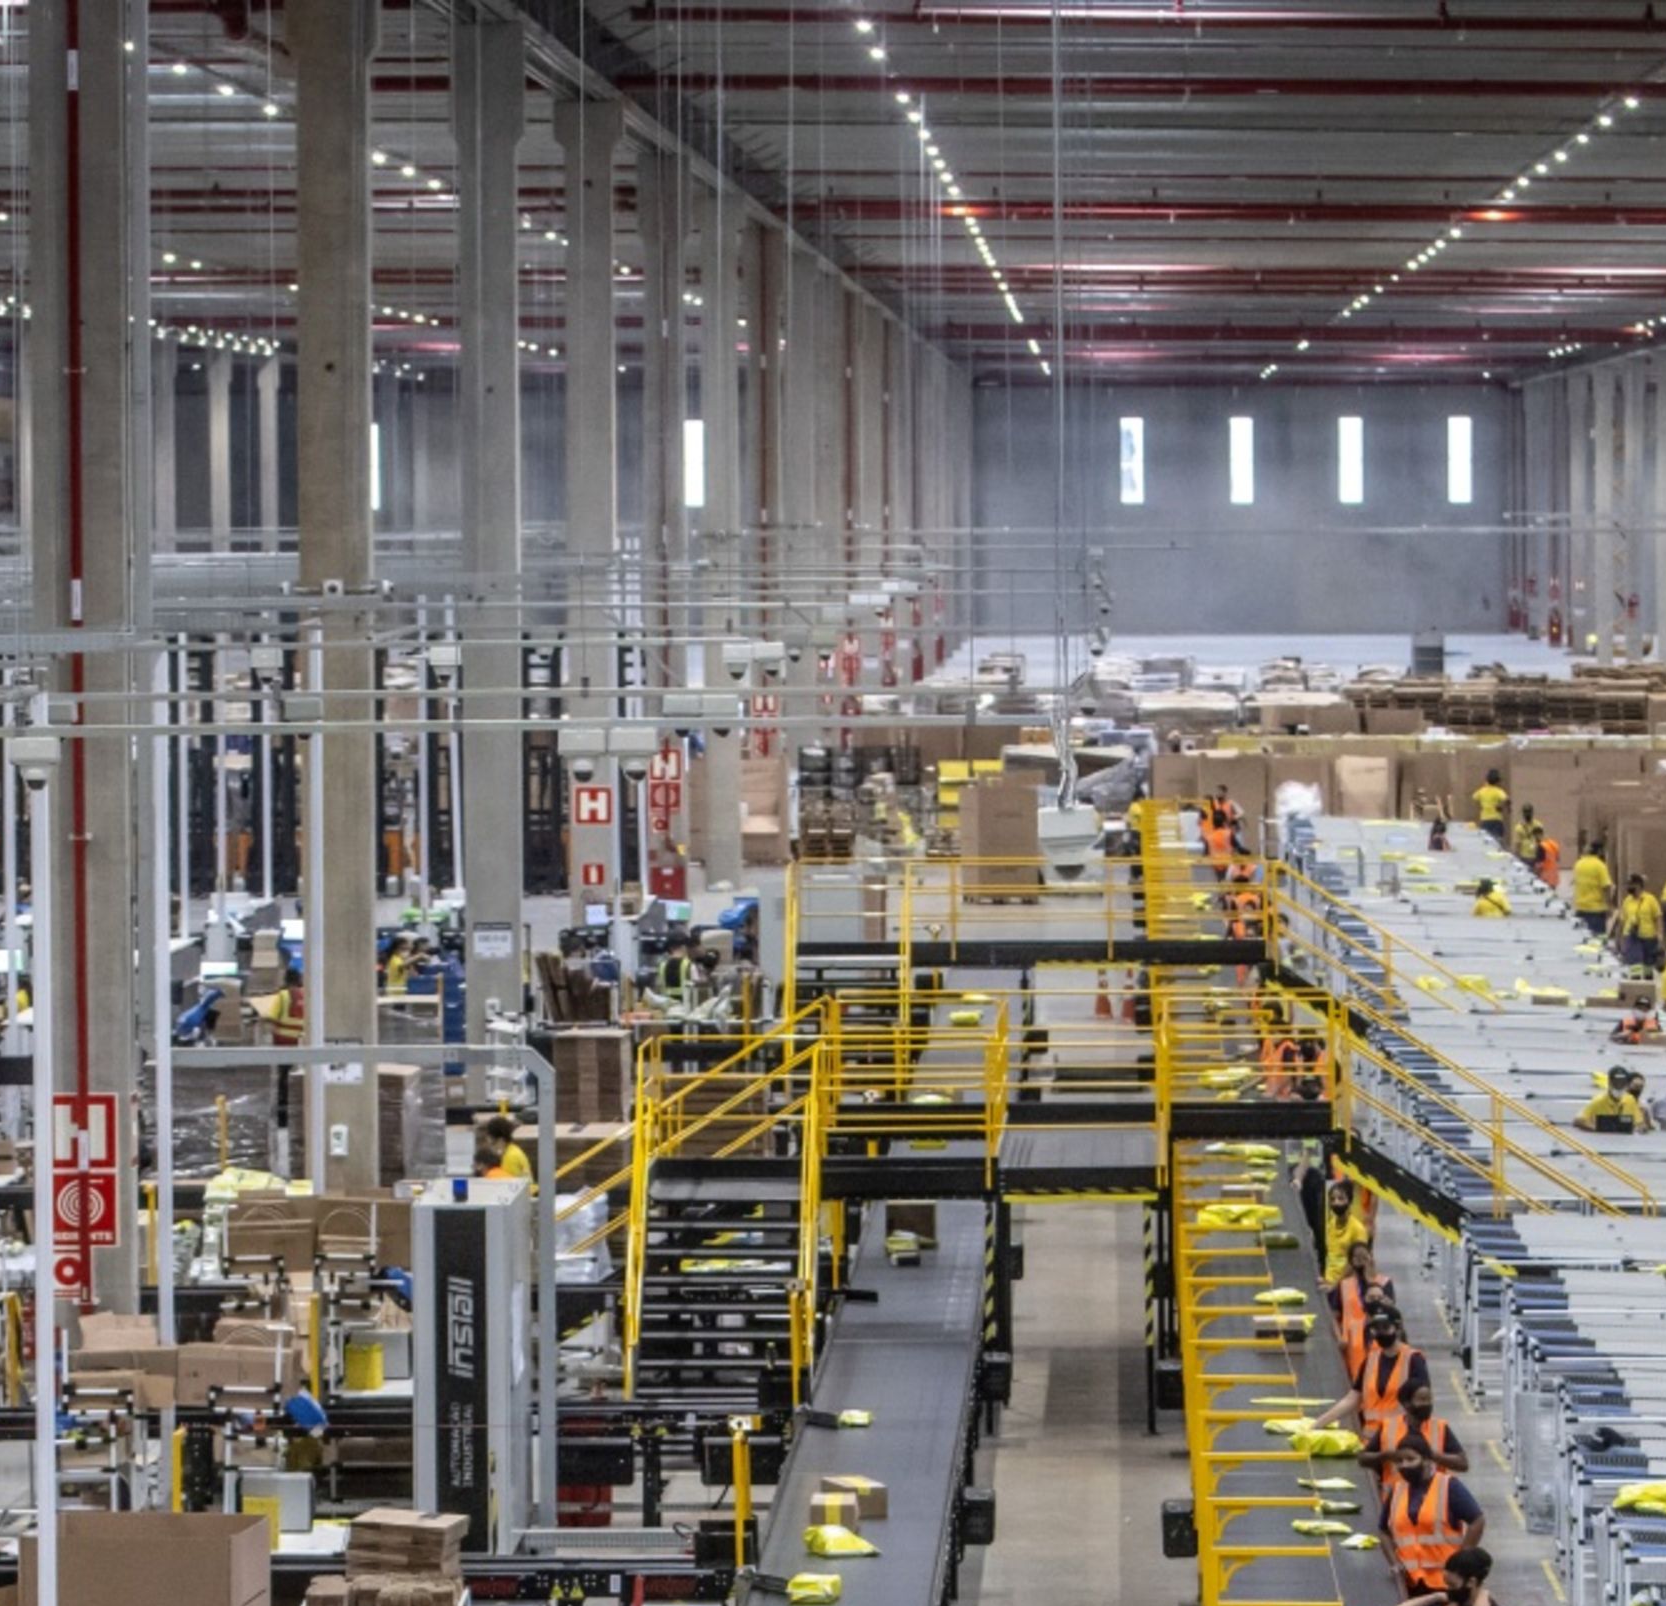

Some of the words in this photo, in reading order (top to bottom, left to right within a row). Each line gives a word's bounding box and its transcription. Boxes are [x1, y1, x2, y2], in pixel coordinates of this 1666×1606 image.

[652, 751, 679, 778] H
[579, 791, 608, 821] H
[54, 1104, 107, 1161] H
[448, 1275, 475, 1380] install
